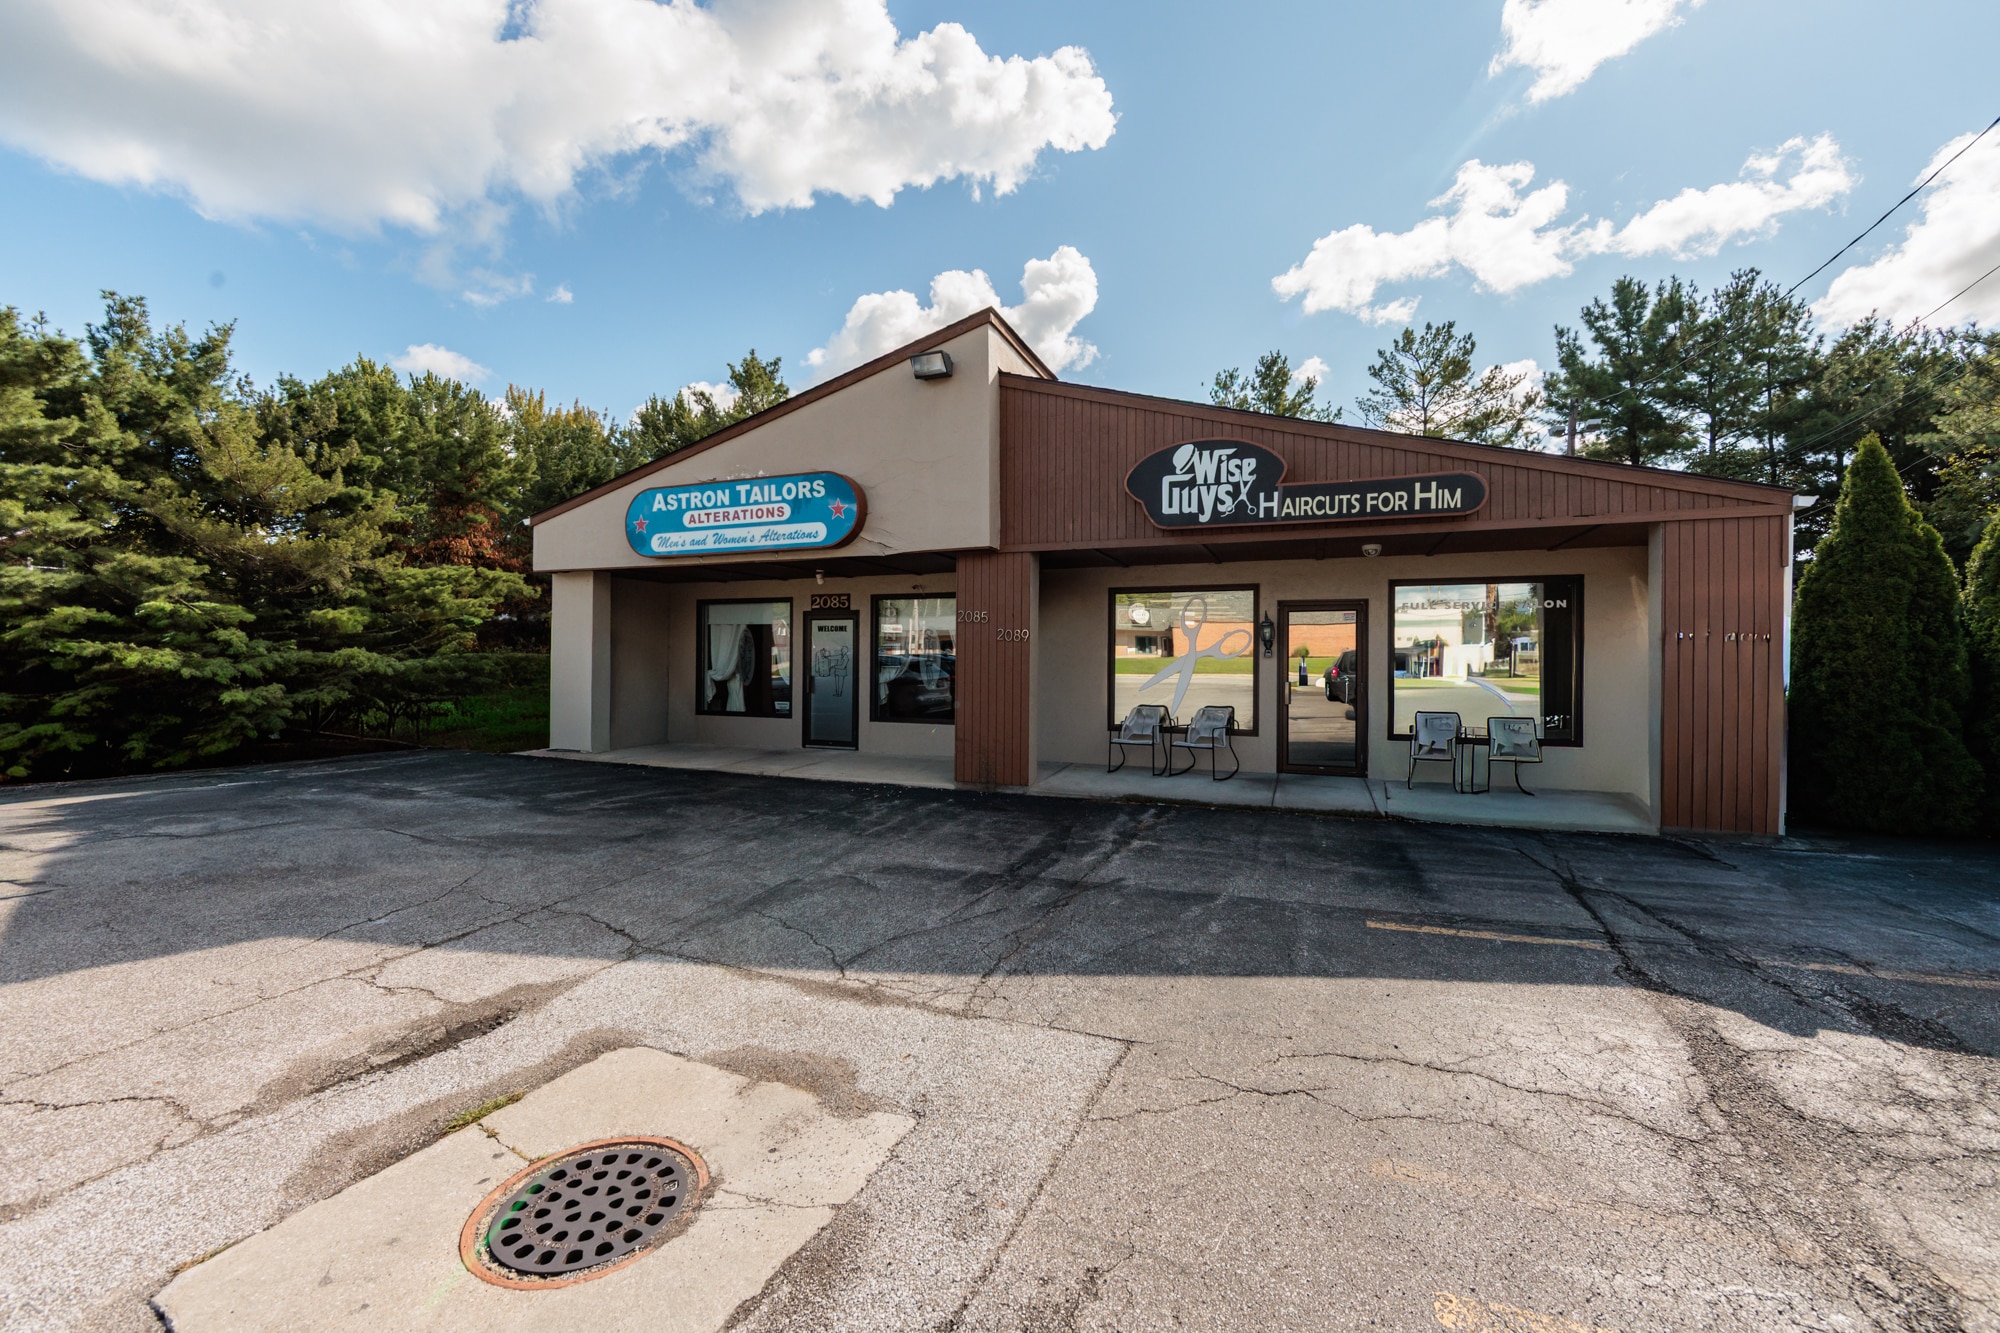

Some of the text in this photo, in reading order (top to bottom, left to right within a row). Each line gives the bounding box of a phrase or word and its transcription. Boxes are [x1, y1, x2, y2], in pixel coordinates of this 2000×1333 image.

[652, 480, 826, 512] ASTRON TAILORS
[1258, 481, 1462, 519] HAIRCUTS FOR HIM
[687, 506, 786, 525] ALTERATIONS
[657, 527, 820, 549] Men's and Women's Alterations
[811, 595, 849, 609] 2085
[1401, 601, 1437, 611] FULL
[957, 610, 989, 624] 2085
[817, 625, 848, 633] WELCOME
[996, 628, 1030, 642] 2089
